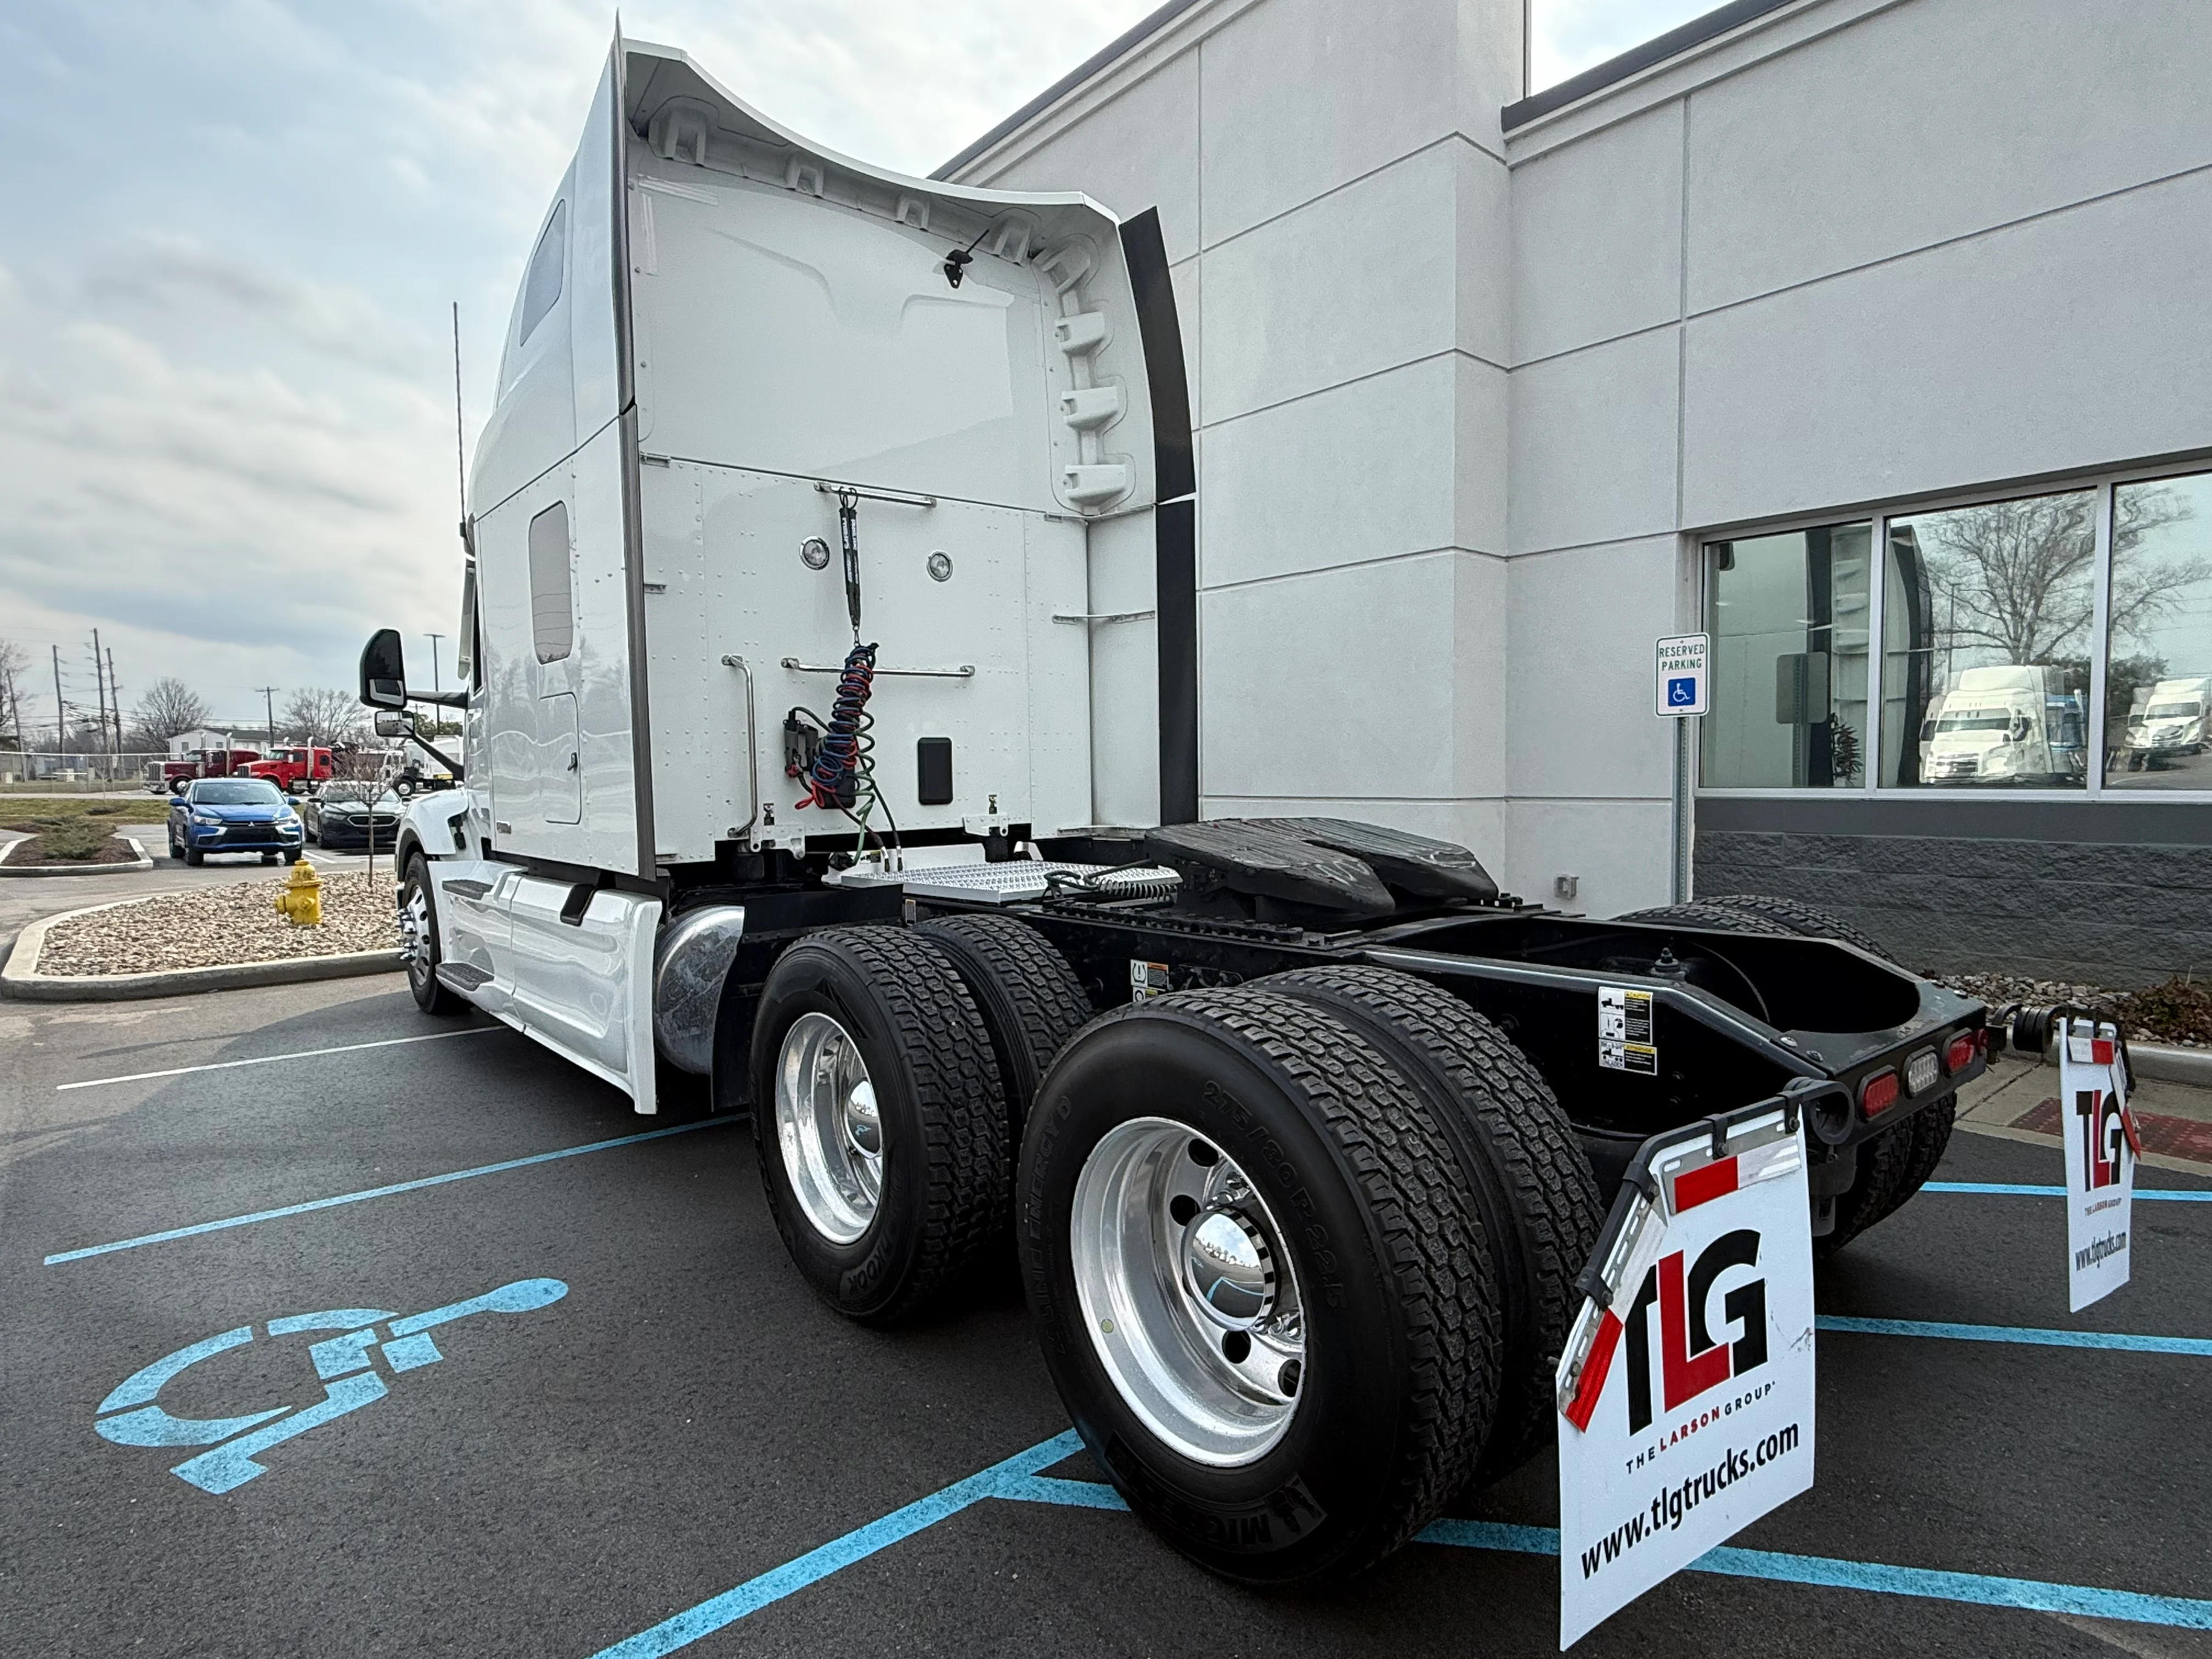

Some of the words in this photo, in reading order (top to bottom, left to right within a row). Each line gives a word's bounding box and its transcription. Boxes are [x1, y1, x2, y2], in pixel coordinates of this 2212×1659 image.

[1659, 644, 1705, 658] RESERVED
[1662, 658, 1702, 671] PARKING
[2076, 1090, 2122, 1193] TLG
[2075, 1229, 2126, 1271] www.tlgtrucks.com
[1625, 1229, 1768, 1436] TLG
[1626, 1446, 1655, 1474] THE
[1660, 1406, 1720, 1452] LARSON
[1724, 1383, 1771, 1415] GROUP
[1581, 1423, 1799, 1579] www.tlgtrucks.com
